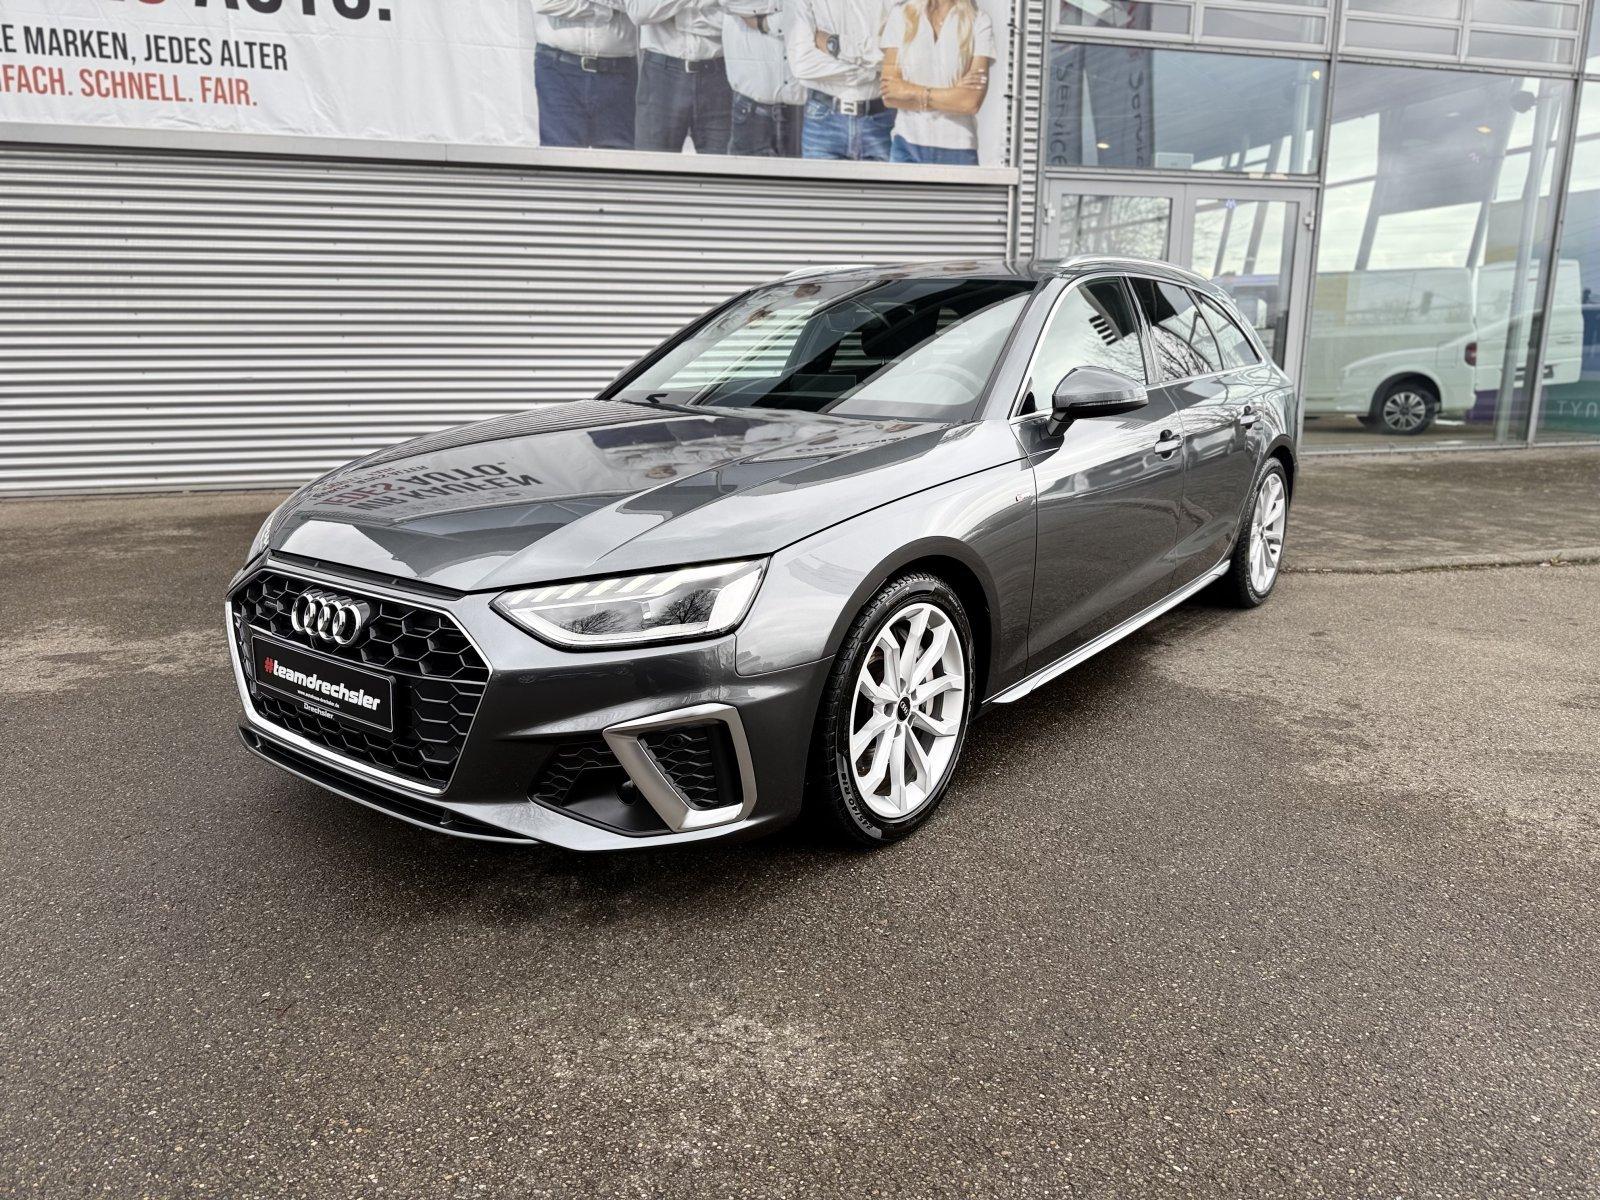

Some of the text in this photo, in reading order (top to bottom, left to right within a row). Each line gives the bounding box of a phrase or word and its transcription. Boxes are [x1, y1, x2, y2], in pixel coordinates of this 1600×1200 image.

[0, 24, 288, 71] E MARKEN, JEDES ALTER
[0, 64, 258, 107] FACH. SCHNELL. FAIR.
[264, 656, 381, 711] #teamdrechsler
